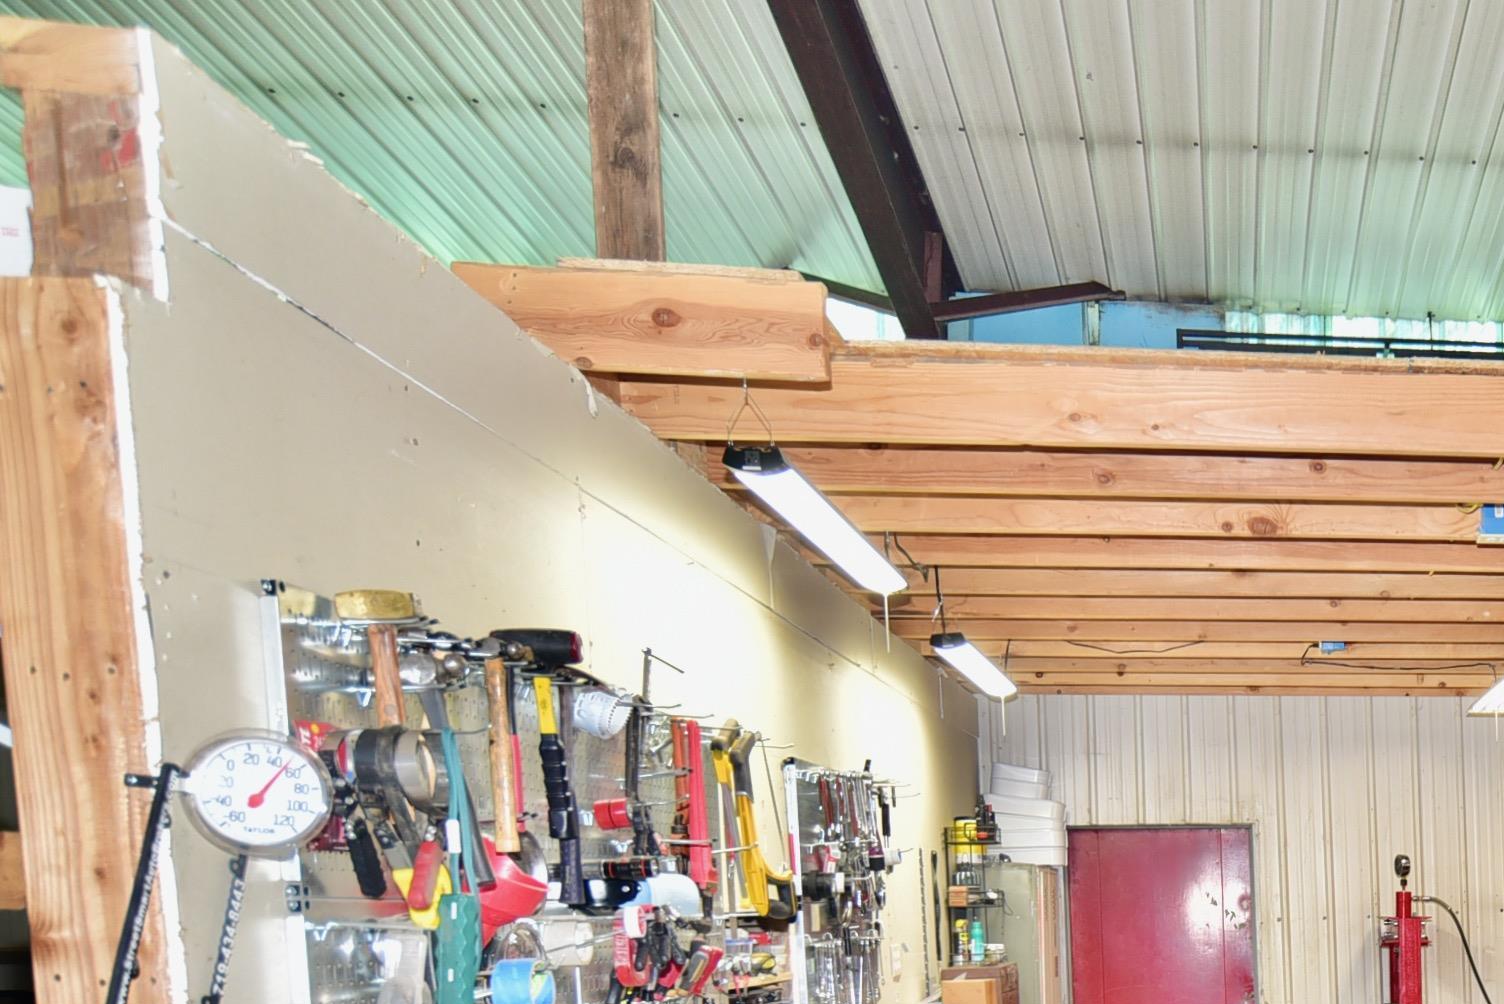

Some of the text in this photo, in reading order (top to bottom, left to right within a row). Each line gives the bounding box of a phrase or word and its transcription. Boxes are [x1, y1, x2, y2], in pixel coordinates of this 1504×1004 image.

[243, 753, 260, 765] 20
[267, 757, 283, 768] 40
[226, 760, 235, 771] 0
[285, 768, 301, 779] 60
[294, 783, 310, 795] 80
[287, 800, 309, 812] 100
[273, 813, 295, 827] 120
